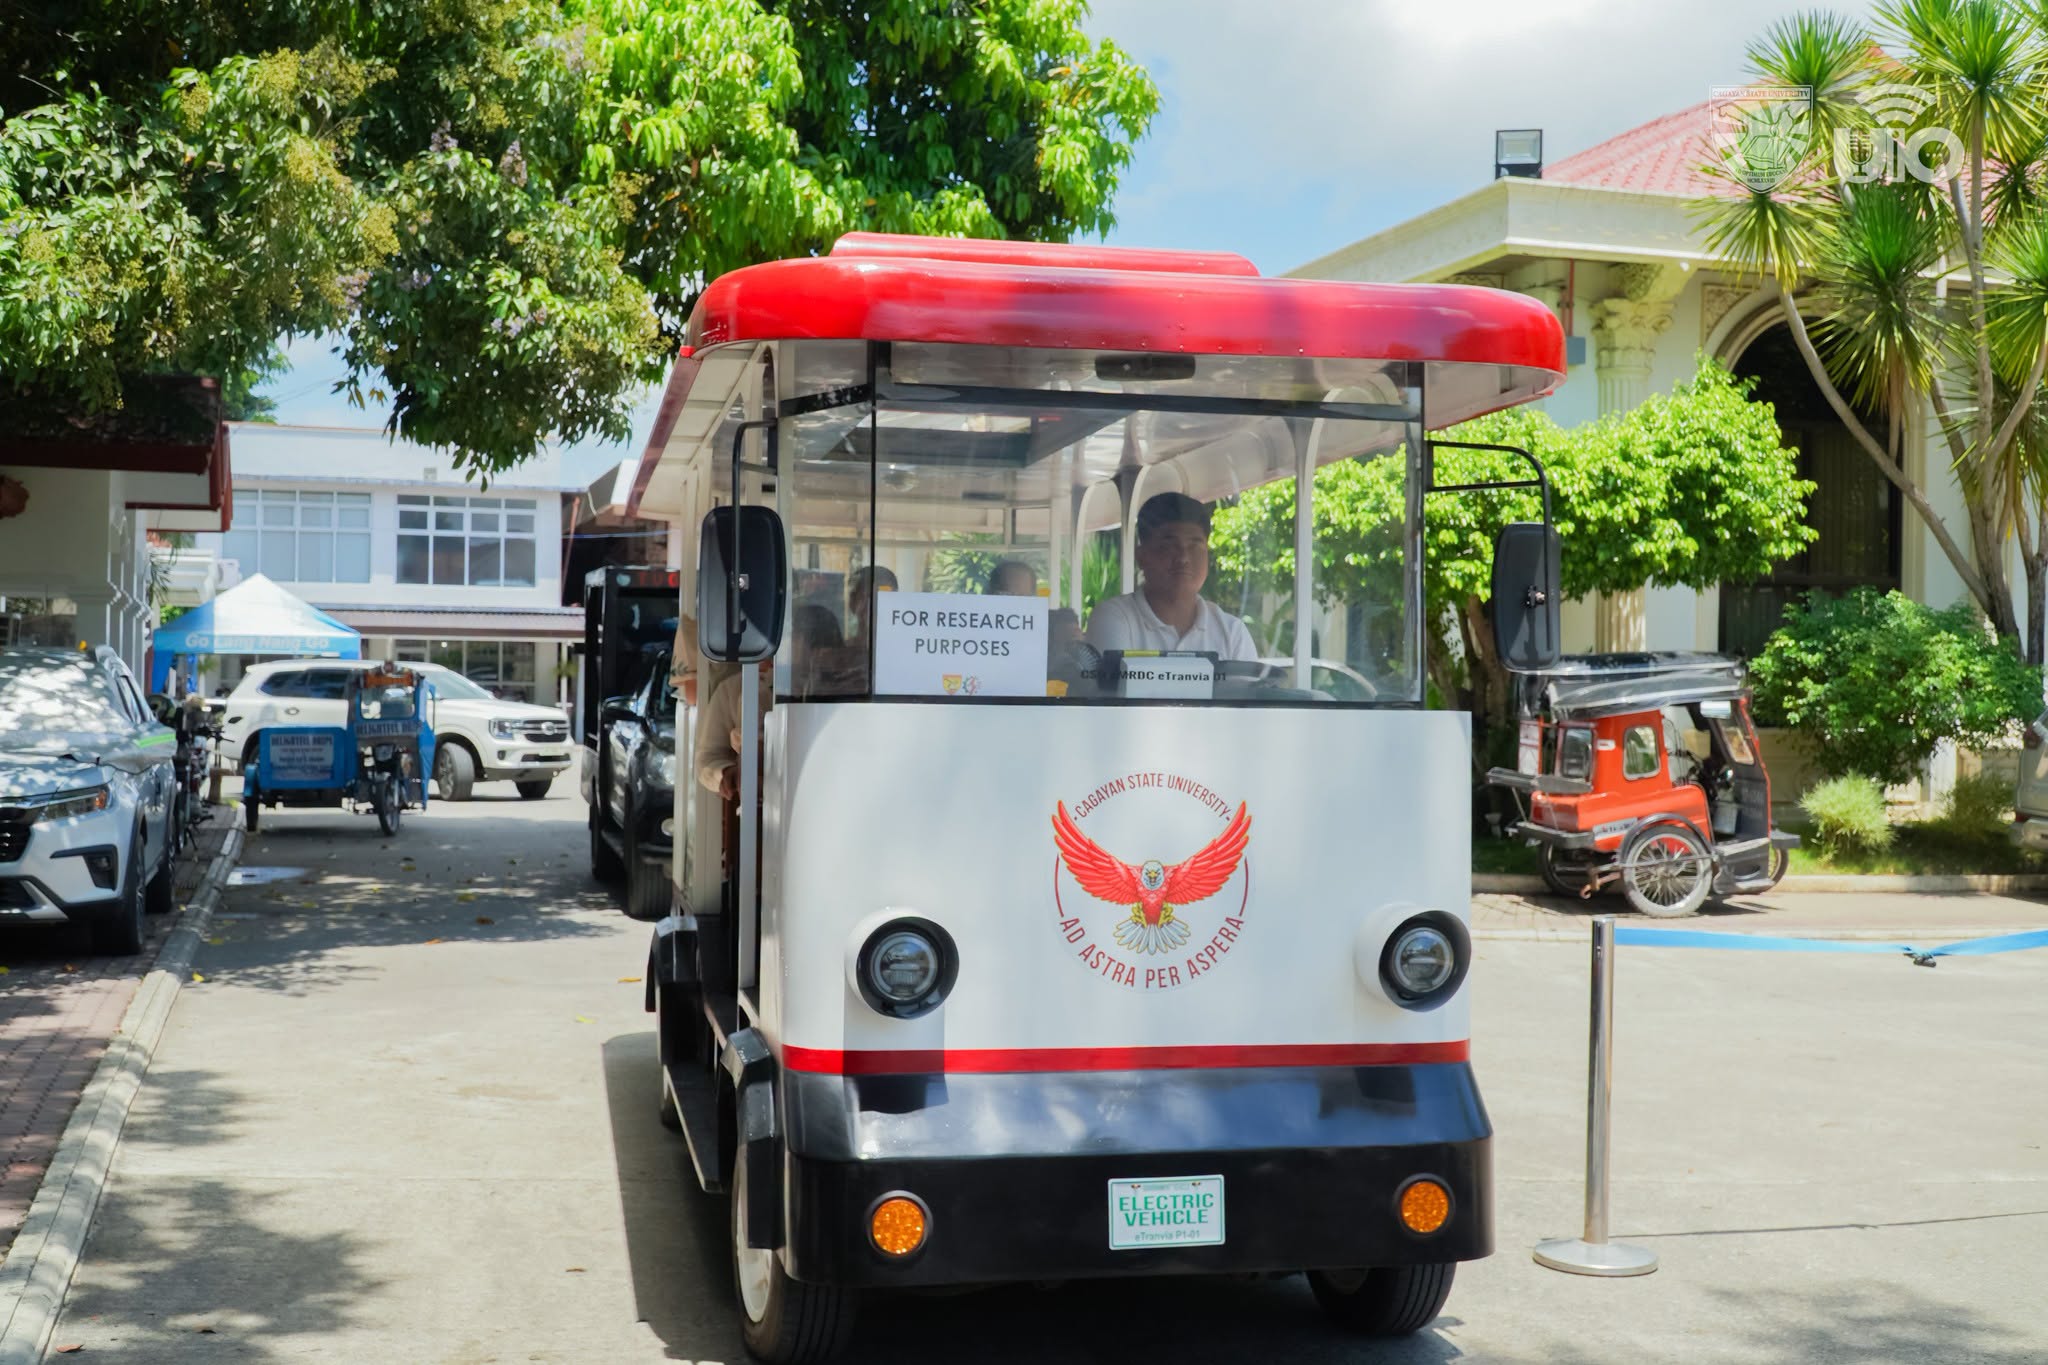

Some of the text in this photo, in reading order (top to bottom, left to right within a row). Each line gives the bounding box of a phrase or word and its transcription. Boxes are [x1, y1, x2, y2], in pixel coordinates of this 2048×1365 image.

[892, 610, 1034, 630] FOR RESEARCH
[186, 632, 209, 648] Go
[915, 638, 1010, 656] PURPOSES
[1158, 671, 1210, 682] eTranvia
[1074, 772, 1232, 818] CAGAYAN STATE UNIVERSITY
[1059, 916, 1245, 989] AD ASTRA PER ASPERA
[1119, 1193, 1214, 1211] ELECTRIC
[1124, 1209, 1209, 1226] VEHICLE
[1135, 1230, 1174, 1242] eTranvia
